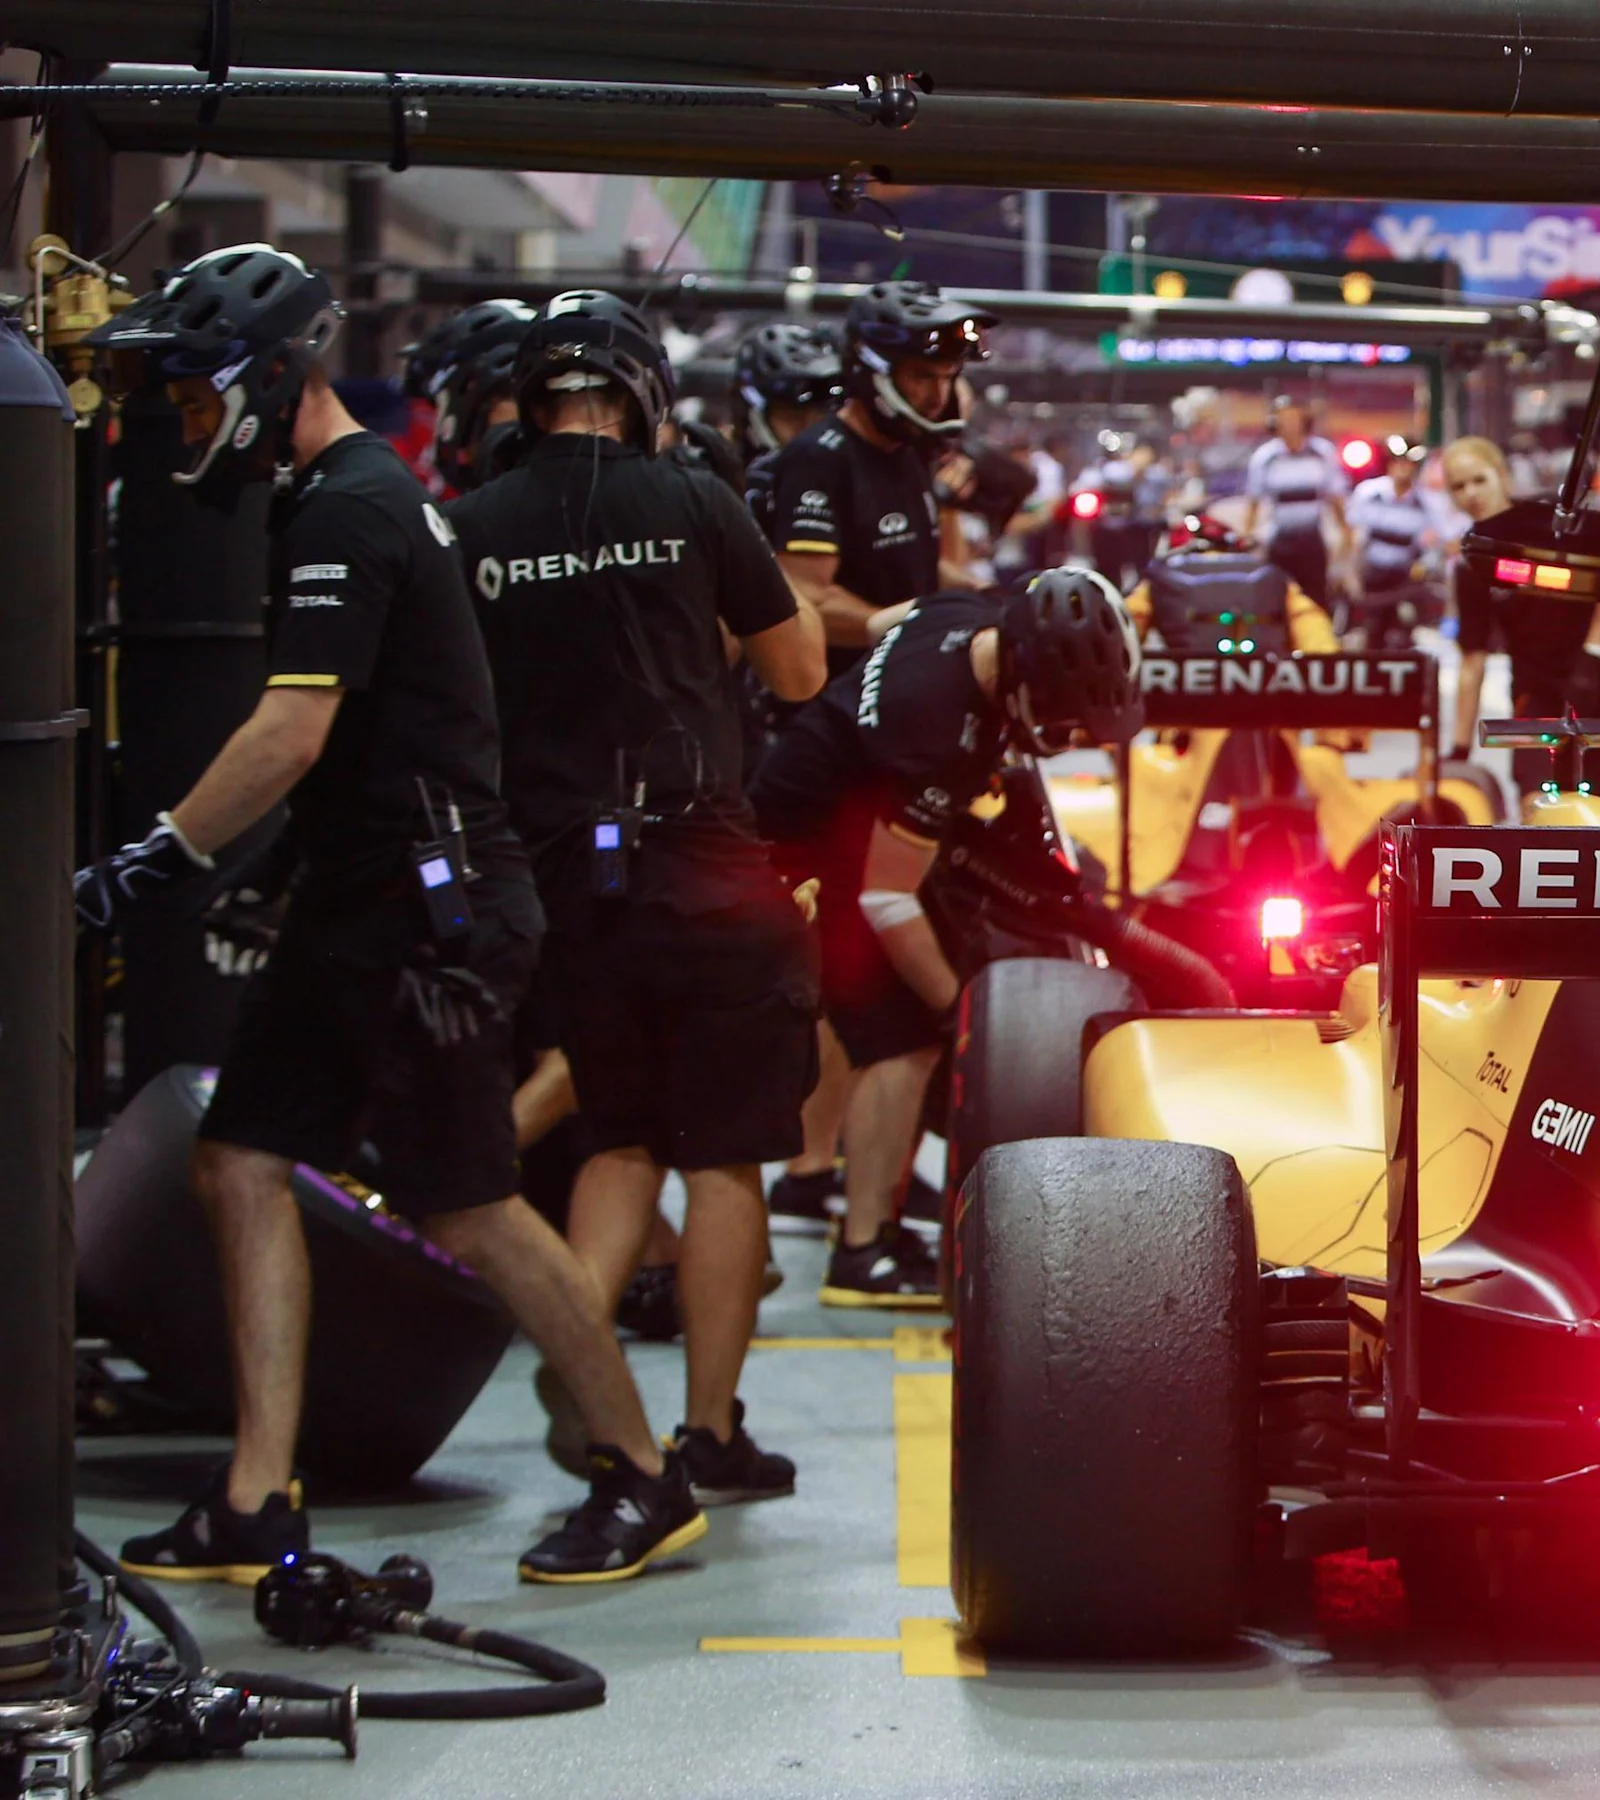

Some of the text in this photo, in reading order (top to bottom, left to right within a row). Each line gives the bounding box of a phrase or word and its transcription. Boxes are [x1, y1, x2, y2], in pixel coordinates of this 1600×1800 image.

[508, 539, 686, 583] RENAULT
[1140, 659, 1416, 693] RENAULT
[1476, 1051, 1513, 1093] TOTAL
